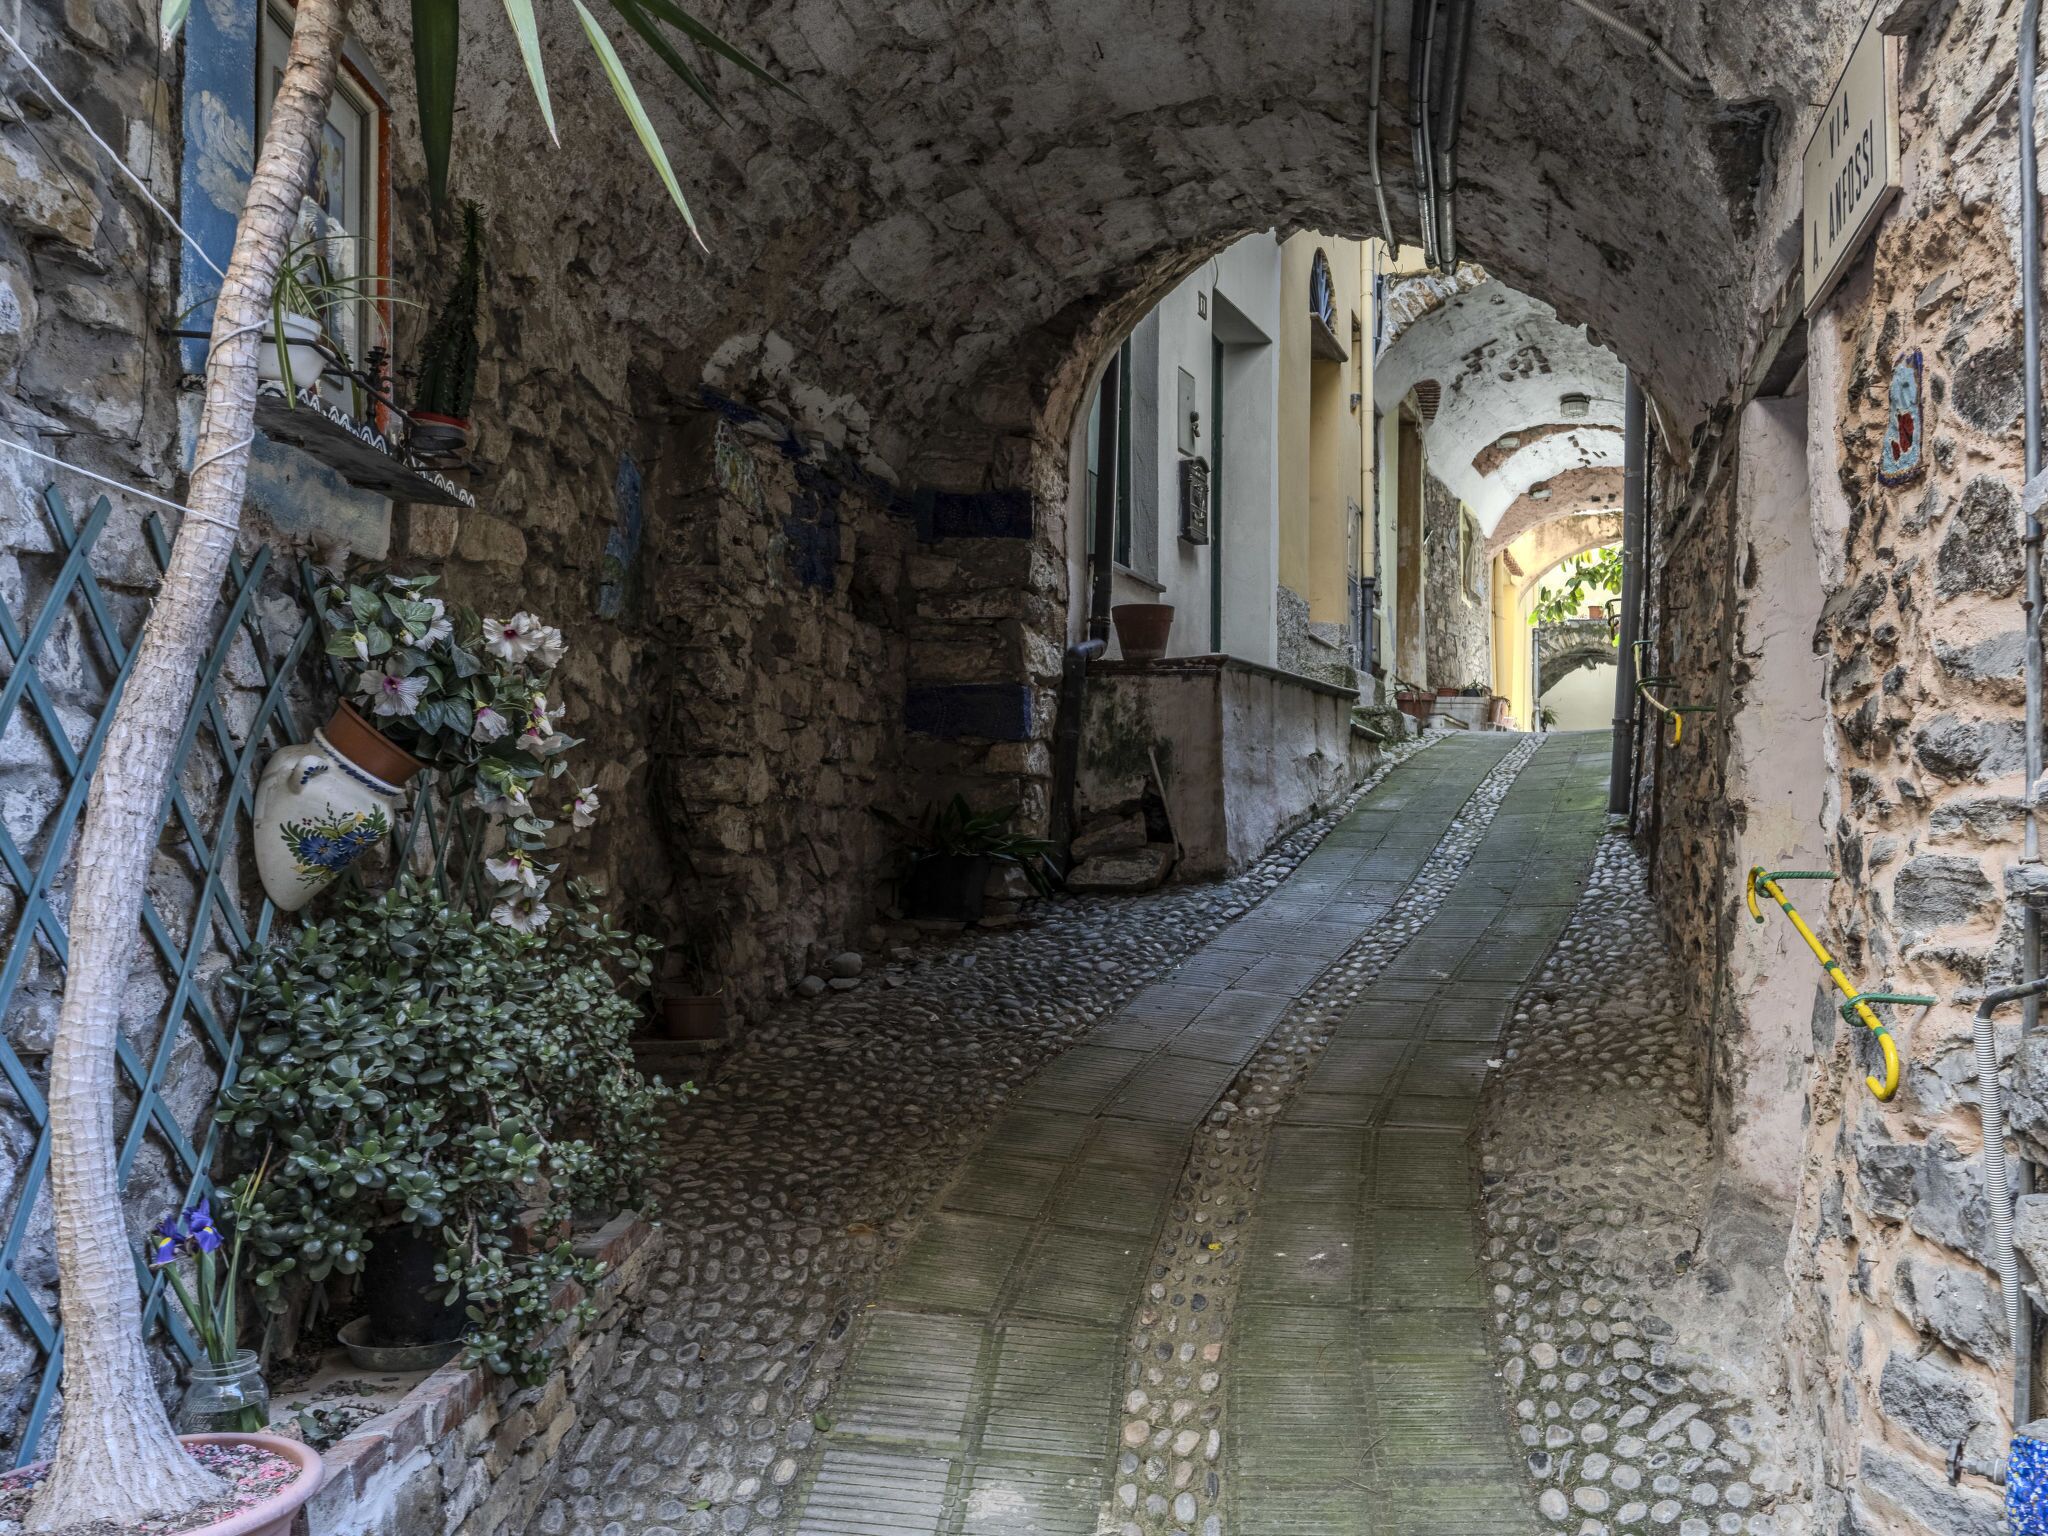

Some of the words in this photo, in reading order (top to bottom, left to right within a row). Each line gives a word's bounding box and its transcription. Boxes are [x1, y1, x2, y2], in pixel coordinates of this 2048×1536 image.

[1829, 91, 1850, 159] VIA
[1813, 220, 1823, 273] A.
[1829, 119, 1874, 248] ANFOSSI
